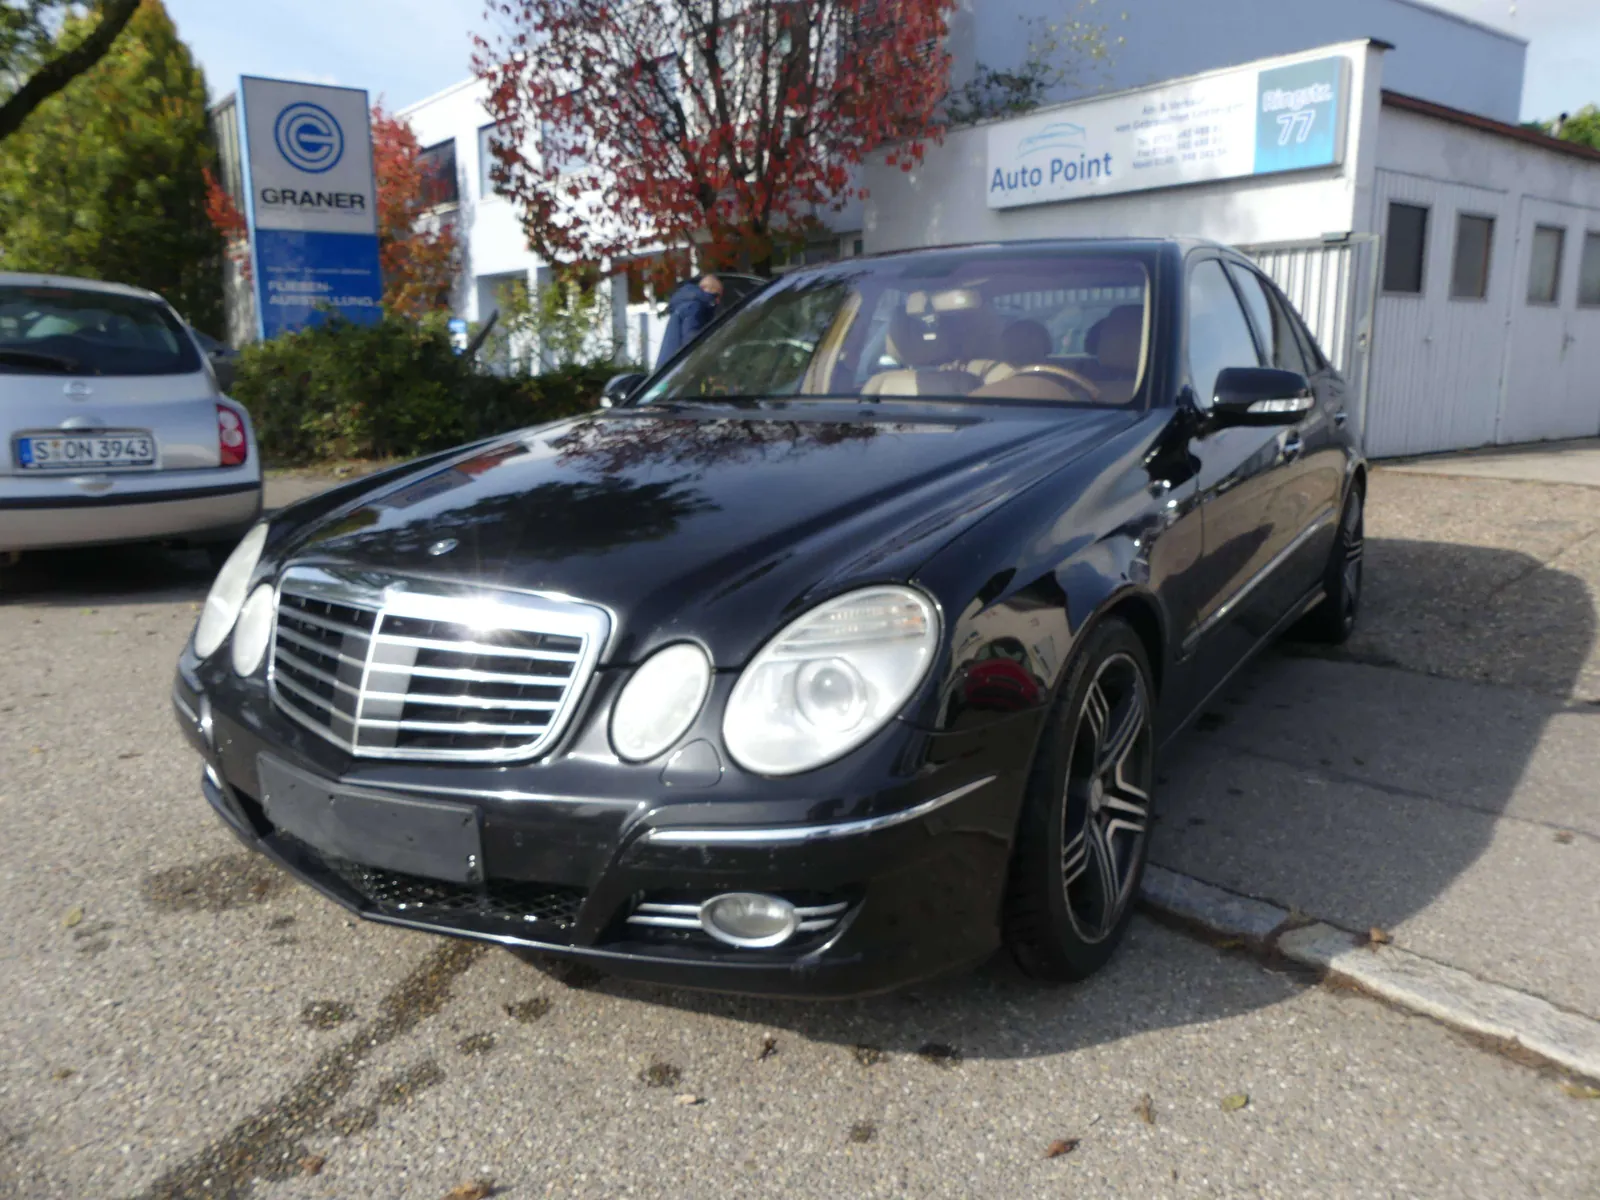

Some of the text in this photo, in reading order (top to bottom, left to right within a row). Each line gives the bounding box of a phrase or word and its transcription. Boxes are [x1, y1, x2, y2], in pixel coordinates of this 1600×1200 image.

[1276, 109, 1316, 146] 77
[990, 166, 1042, 193] Auto
[1051, 152, 1112, 184] Point
[261, 188, 366, 210] GRANER
[35, 439, 149, 460] S ON 3943
